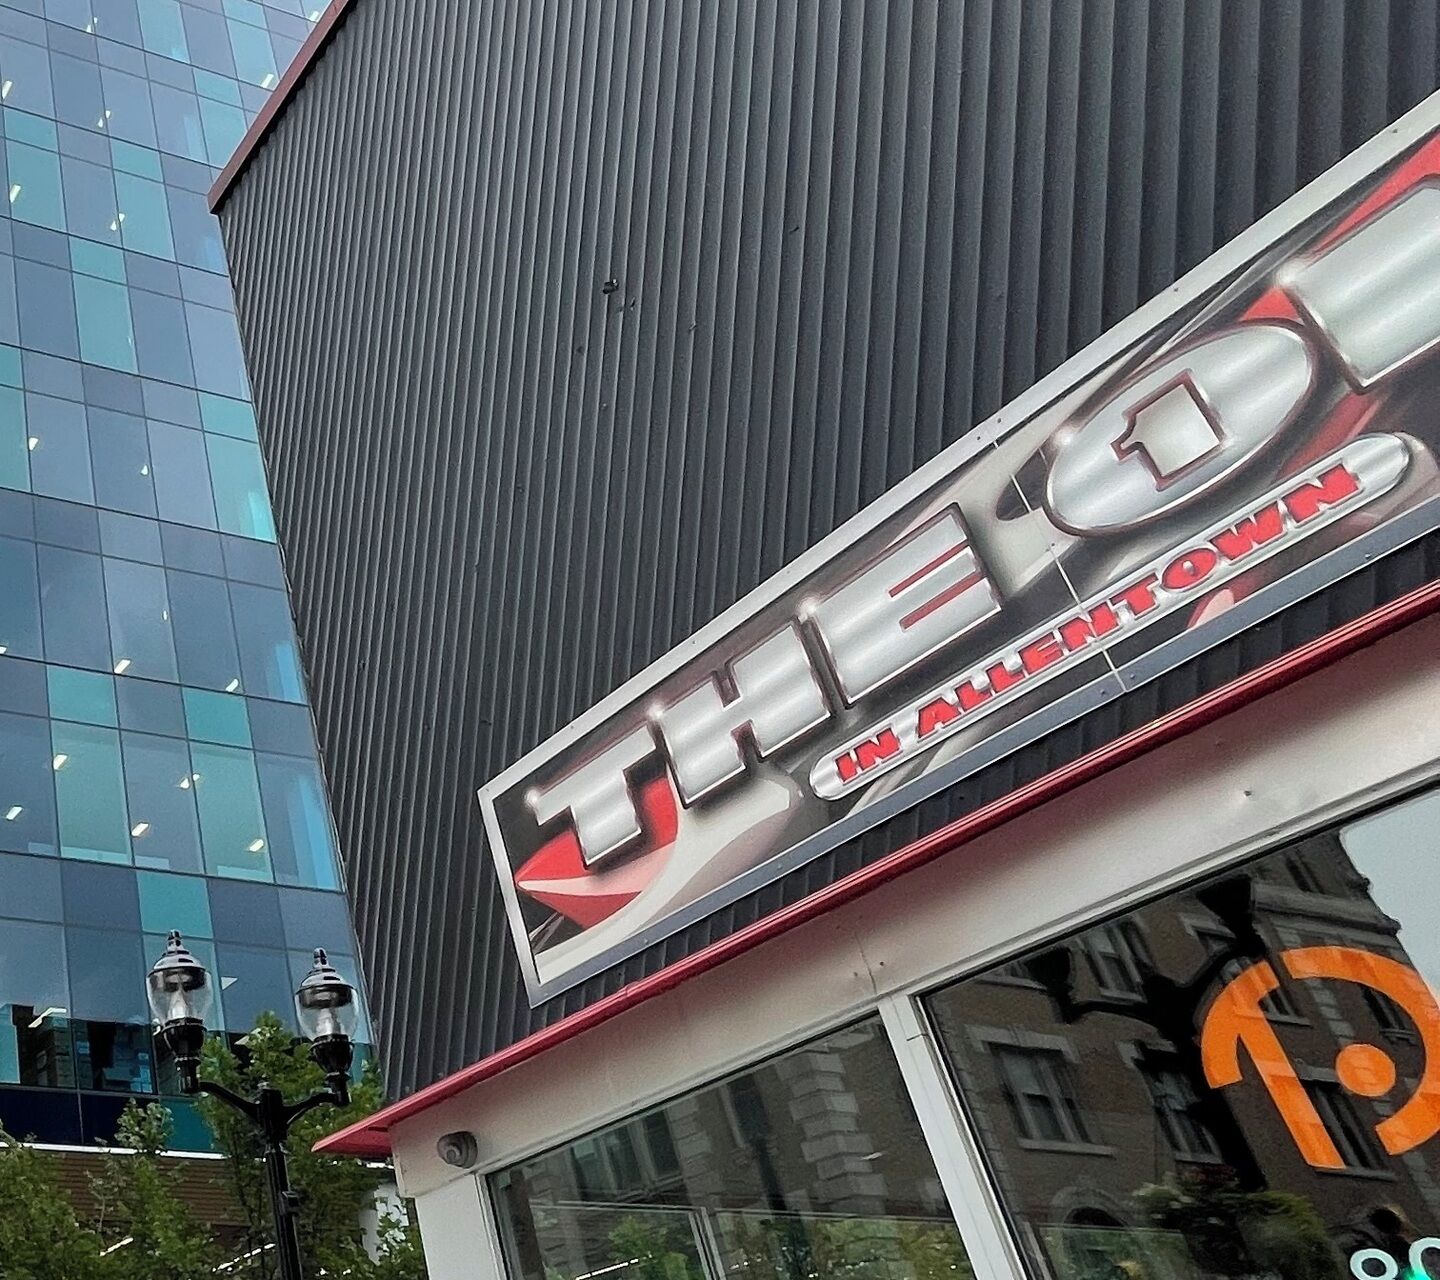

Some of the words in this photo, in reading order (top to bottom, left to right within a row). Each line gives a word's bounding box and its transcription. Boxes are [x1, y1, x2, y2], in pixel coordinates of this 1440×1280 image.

[532, 503, 1003, 868] THE
[836, 726, 901, 784] IN
[916, 462, 1361, 740] ALLENTOWN
